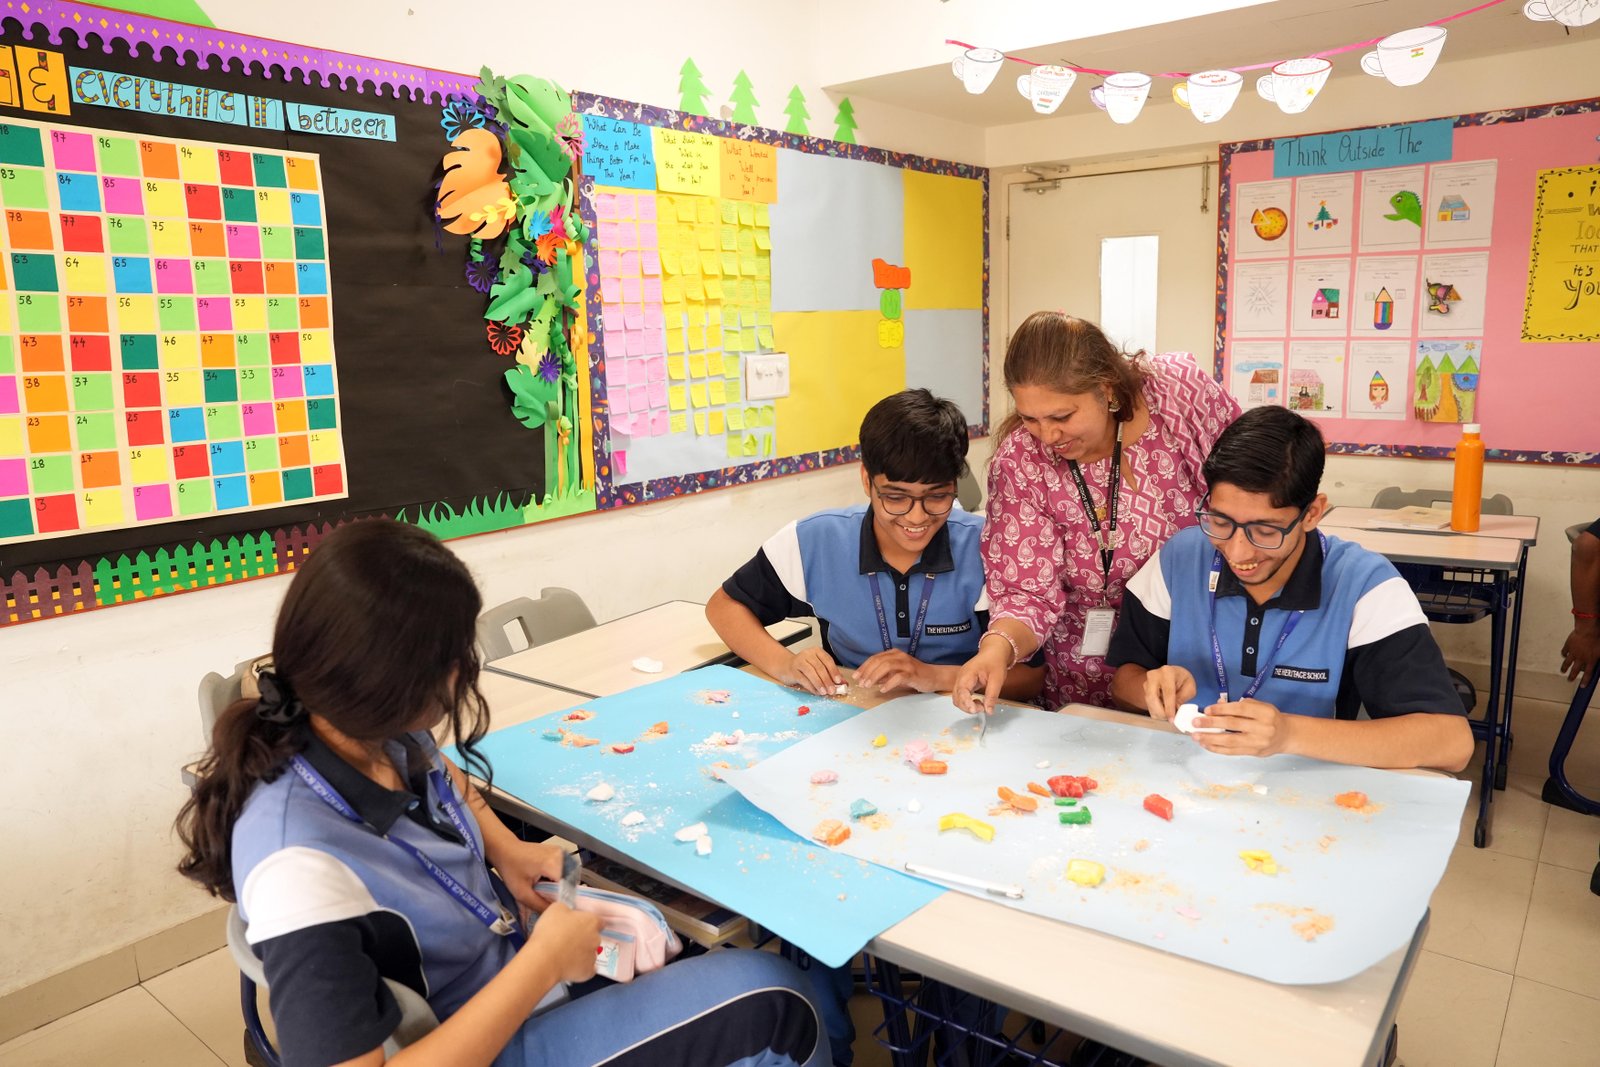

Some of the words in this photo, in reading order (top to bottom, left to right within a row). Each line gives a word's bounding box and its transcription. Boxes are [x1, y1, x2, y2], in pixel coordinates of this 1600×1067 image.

[76, 70, 236, 123] everything
[254, 95, 278, 128] in
[298, 104, 388, 139] between
[585, 117, 606, 131] What
[52, 131, 66, 143] 97
[99, 138, 110, 148] 96
[141, 141, 152, 152] 95
[181, 147, 192, 158] 94
[218, 150, 232, 162] 93
[253, 153, 264, 164] 92
[286, 157, 296, 167] 91
[1281, 136, 1327, 167] Think
[1338, 134, 1385, 163] Outside
[1394, 126, 1423, 155] The
[0, 169, 16, 180] 83
[59, 174, 71, 184] 84
[103, 177, 115, 188] 85
[147, 182, 157, 191] 86
[187, 185, 198, 195] 87
[222, 188, 235, 199] 88
[259, 192, 268, 200] 89
[291, 193, 302, 204] 90
[8, 212, 22, 221] 78
[61, 215, 76, 226] 77
[109, 218, 122, 228] 76
[152, 222, 164, 231] 75
[191, 224, 202, 233] 74
[227, 225, 238, 236] 73
[262, 227, 272, 235] 72
[12, 253, 28, 264] 63
[66, 257, 79, 267] 64
[113, 257, 127, 269] 65
[157, 261, 167, 270] 66
[195, 262, 205, 270] 67
[230, 262, 242, 273] 68
[265, 262, 274, 271] 69
[297, 263, 309, 273] 70
[1573, 264, 1594, 277] it's
[19, 295, 32, 304] 58
[69, 297, 83, 307] 57
[120, 298, 130, 307] 56
[160, 299, 172, 308] 55
[199, 299, 209, 308] 54
[235, 299, 245, 307] 53
[299, 299, 310, 307] 51
[23, 337, 37, 347] 43
[73, 337, 86, 347] 44
[121, 336, 135, 346] 45
[164, 337, 176, 346] 46
[202, 336, 213, 344] 47
[238, 335, 248, 344] 48
[270, 334, 281, 343] 49
[303, 333, 312, 341] 50
[25, 378, 40, 388] 38
[75, 376, 88, 387] 37
[124, 374, 138, 384] 36
[167, 372, 179, 382] 35
[204, 370, 217, 381] 34
[242, 370, 254, 379] 33
[272, 367, 284, 377] 32
[304, 366, 317, 377] 31
[28, 418, 39, 426] 23
[77, 416, 87, 424] 24
[126, 412, 138, 423] 25
[169, 409, 180, 419] 26
[208, 408, 218, 417] 27
[243, 406, 253, 415] 28
[277, 403, 285, 411] 29
[307, 401, 318, 411] 30
[32, 459, 45, 469] 18
[82, 454, 92, 463] 17
[131, 451, 141, 459] 16
[173, 447, 185, 458] 15
[211, 444, 223, 455] 14
[246, 441, 256, 450] 13
[36, 497, 47, 511] 3
[86, 493, 92, 505] 4
[135, 487, 142, 496] 5
[179, 484, 185, 493] 6
[216, 480, 223, 489] 7
[250, 475, 255, 483] 8
[283, 471, 289, 480] 9
[313, 466, 324, 476] 10
[937, 626, 958, 634] HERITAGE
[1274, 668, 1282, 676] THE
[1281, 668, 1308, 679] HERITAGE
[1307, 670, 1328, 681] SCHOOL
[476, 904, 490, 920] THE
